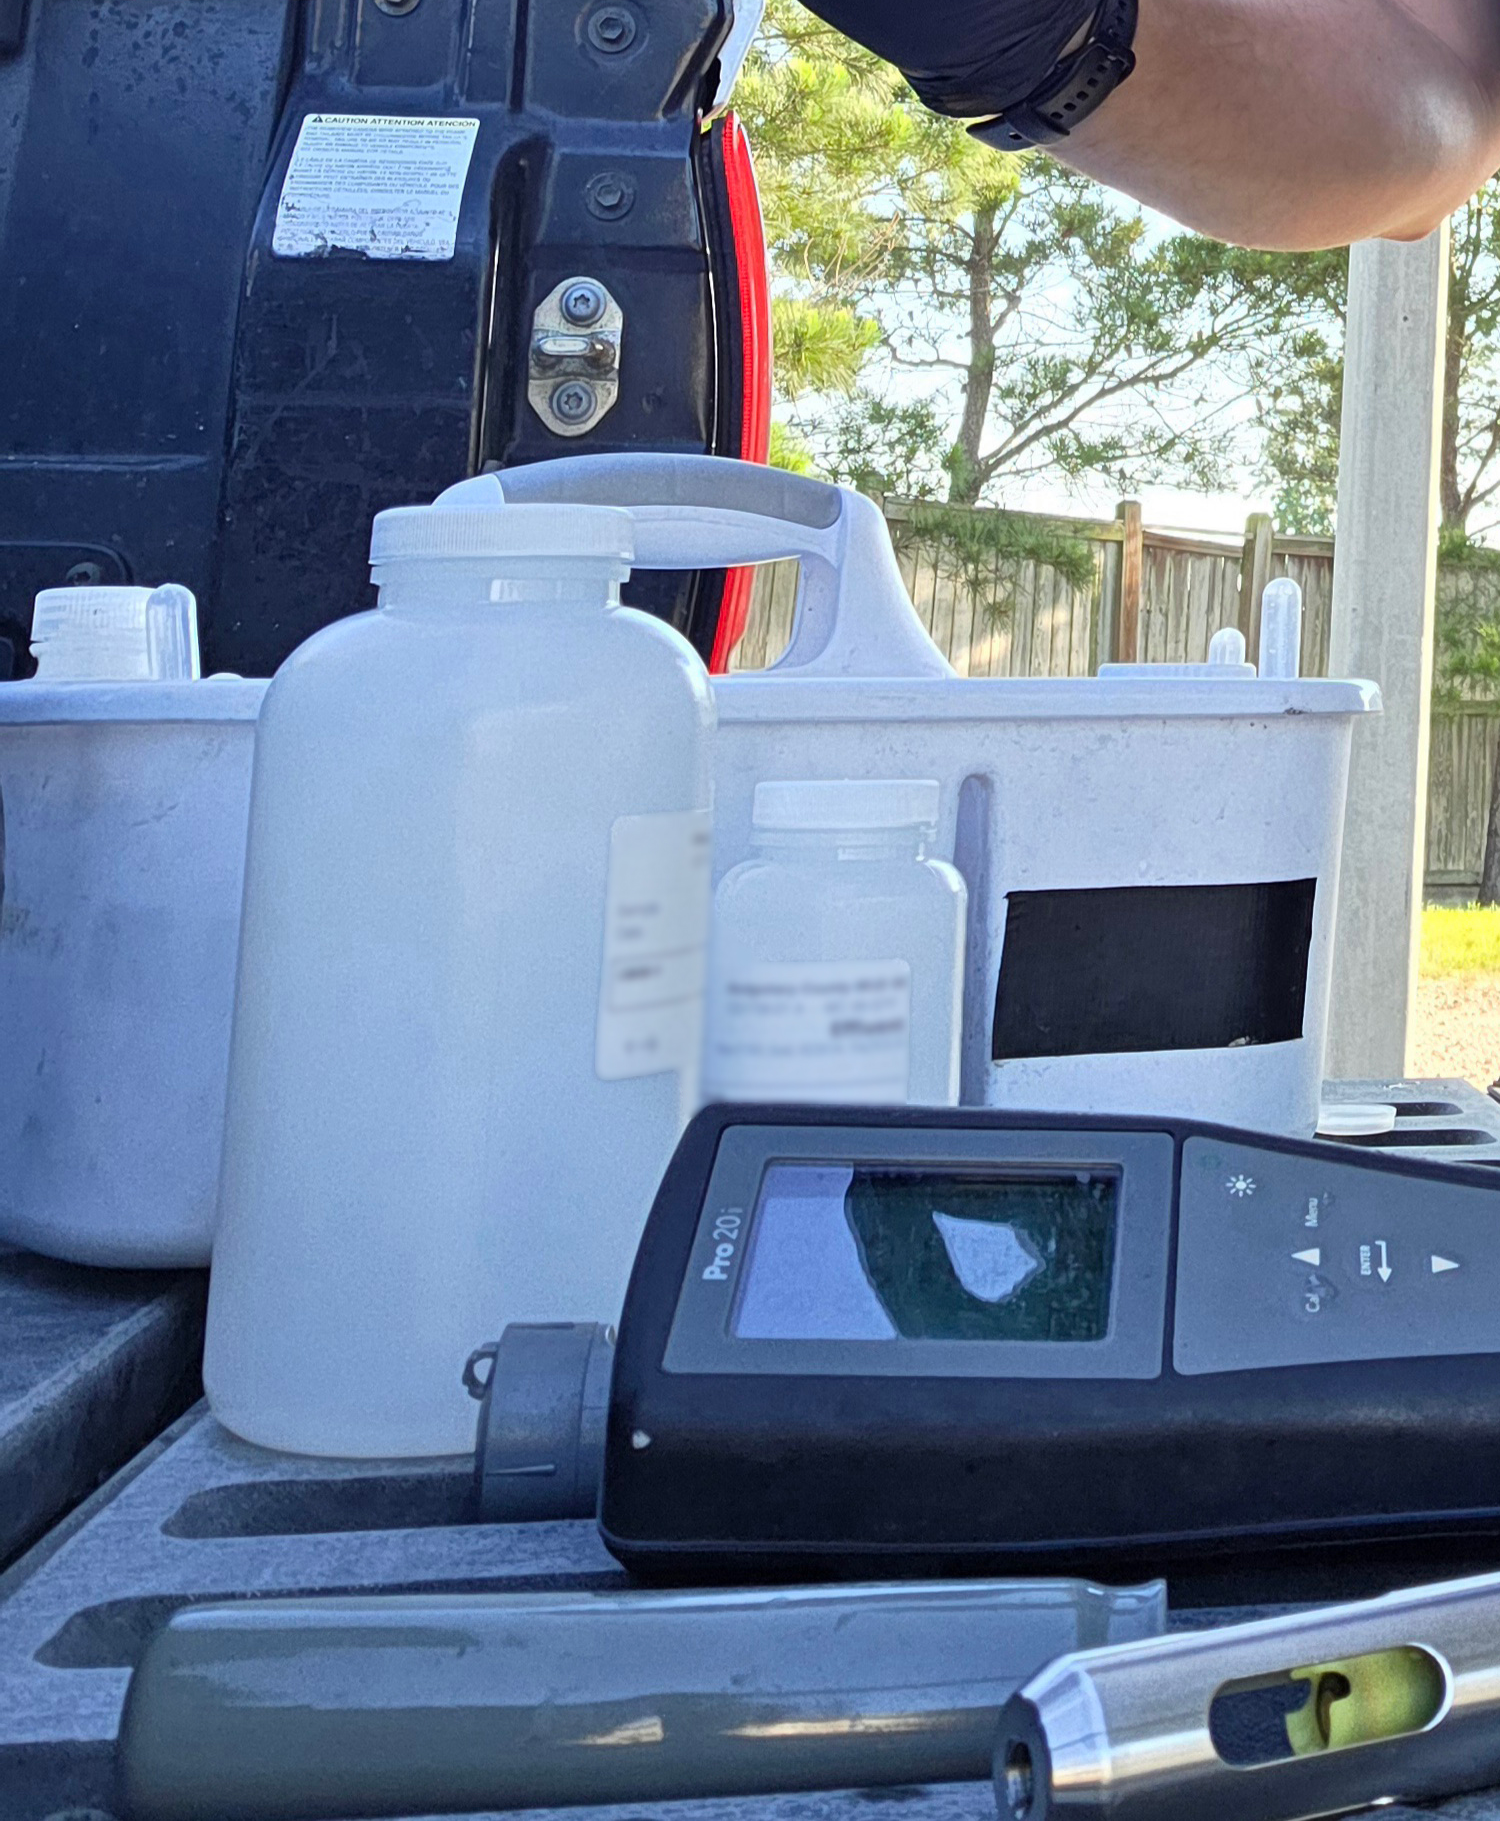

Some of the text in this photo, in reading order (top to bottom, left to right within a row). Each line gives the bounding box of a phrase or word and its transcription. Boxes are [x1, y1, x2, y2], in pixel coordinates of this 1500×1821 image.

[324, 117, 476, 128] CAUTION ATTENTION ATENCIÓN
[1305, 1197, 1318, 1227] Menu
[1360, 1244, 1372, 1276] ENTER
[1304, 1292, 1320, 1313] Cal
